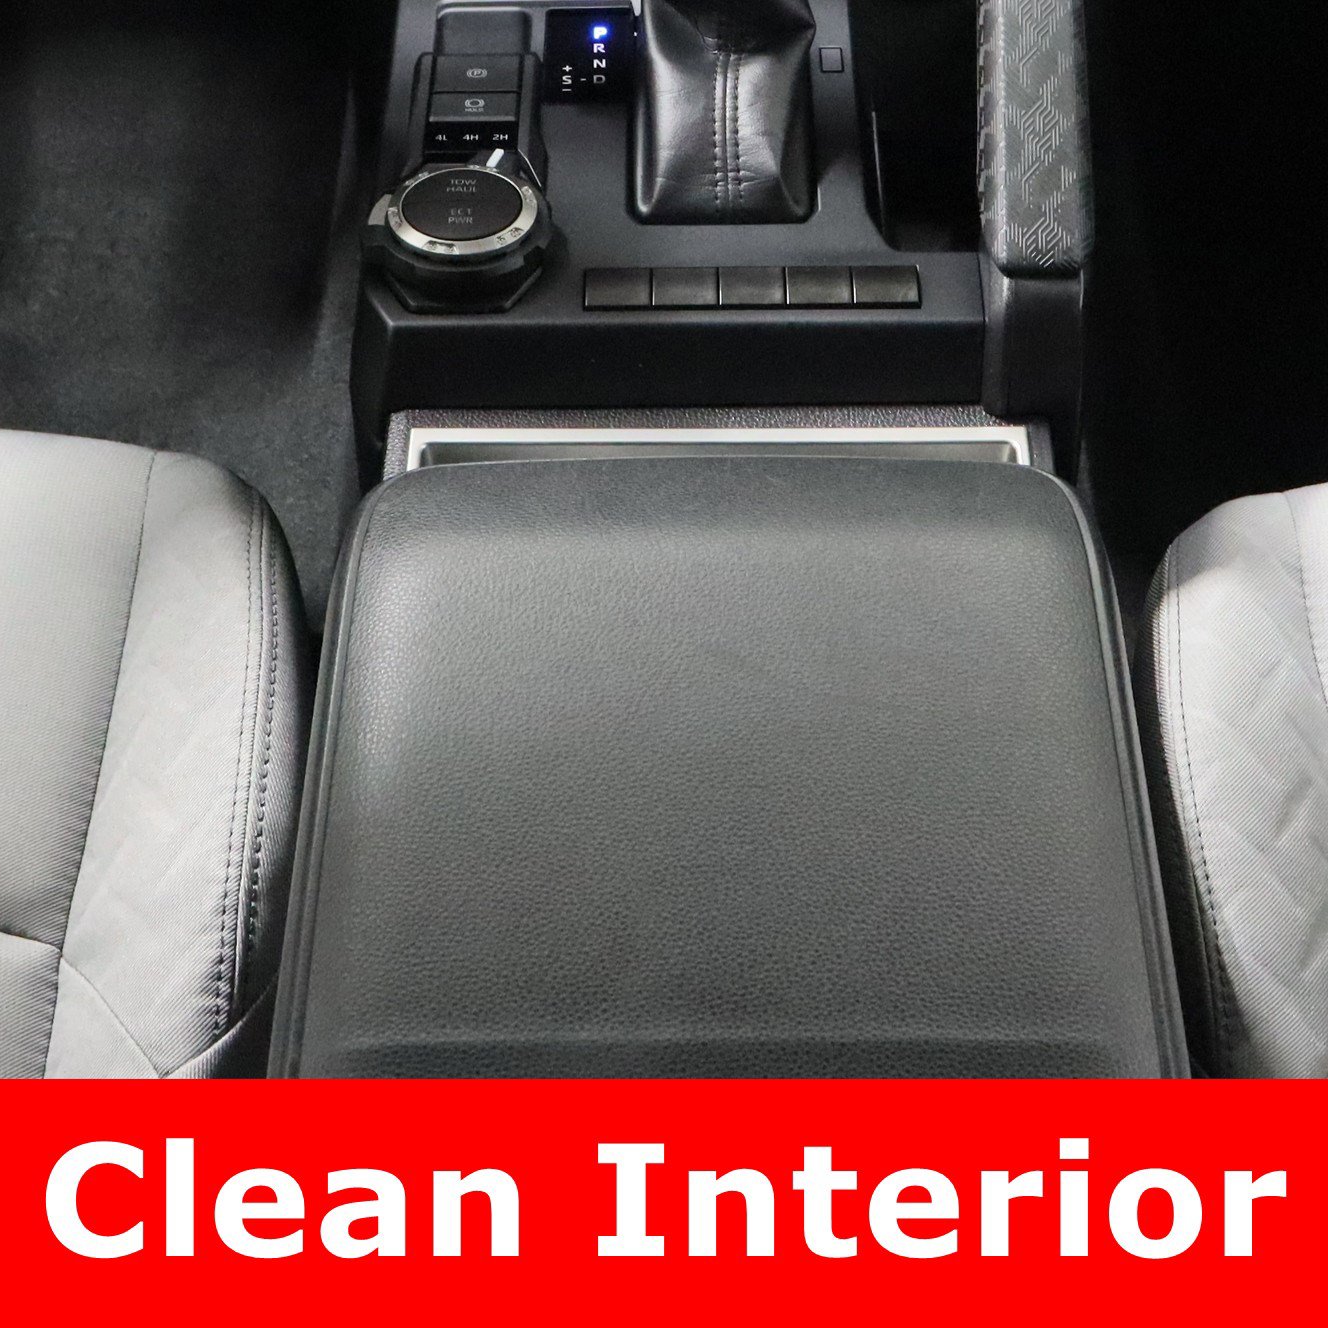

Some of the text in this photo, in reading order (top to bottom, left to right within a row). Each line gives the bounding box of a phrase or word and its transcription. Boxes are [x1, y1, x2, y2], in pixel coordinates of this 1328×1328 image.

[592, 26, 608, 40] P
[593, 43, 606, 53] R
[593, 59, 607, 69] N
[562, 75, 573, 84] S
[593, 74, 606, 84] D
